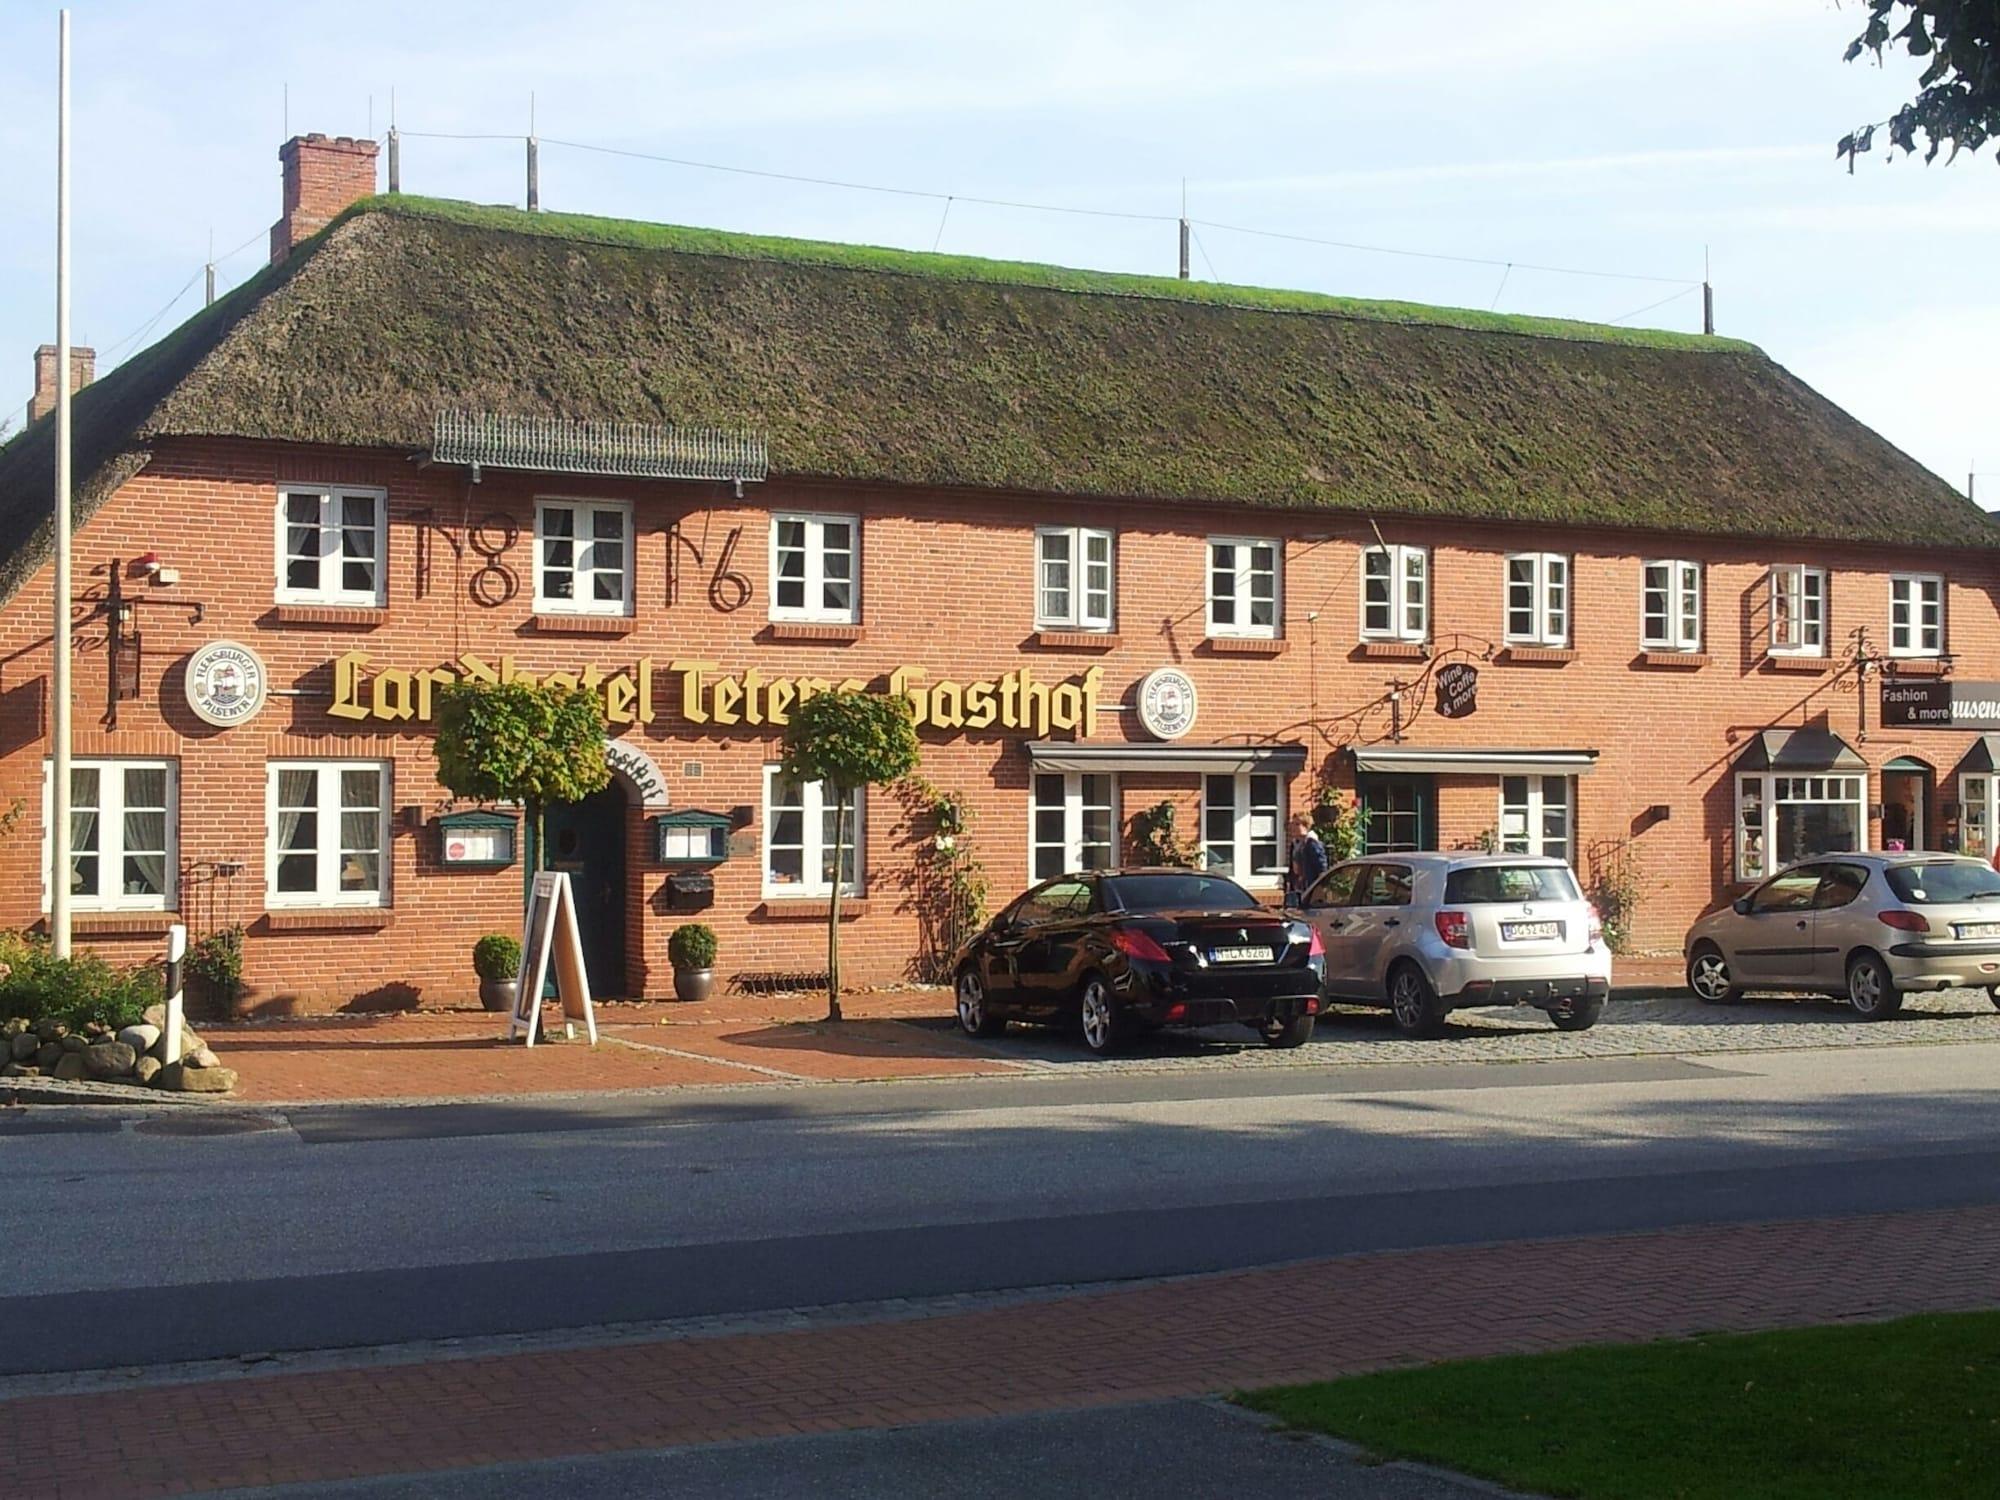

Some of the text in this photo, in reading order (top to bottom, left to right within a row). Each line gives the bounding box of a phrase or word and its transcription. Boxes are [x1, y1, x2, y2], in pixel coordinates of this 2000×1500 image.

[196, 650, 256, 679] FLENSBURGER
[1437, 665, 1462, 690] Wine
[201, 699, 251, 717] PILSENER
[890, 665, 1105, 738] Gasthof
[1443, 684, 1477, 716] & more
[1882, 689, 1928, 702] Fashion
[1907, 706, 1949, 720] & more
[606, 747, 664, 799] asthof
